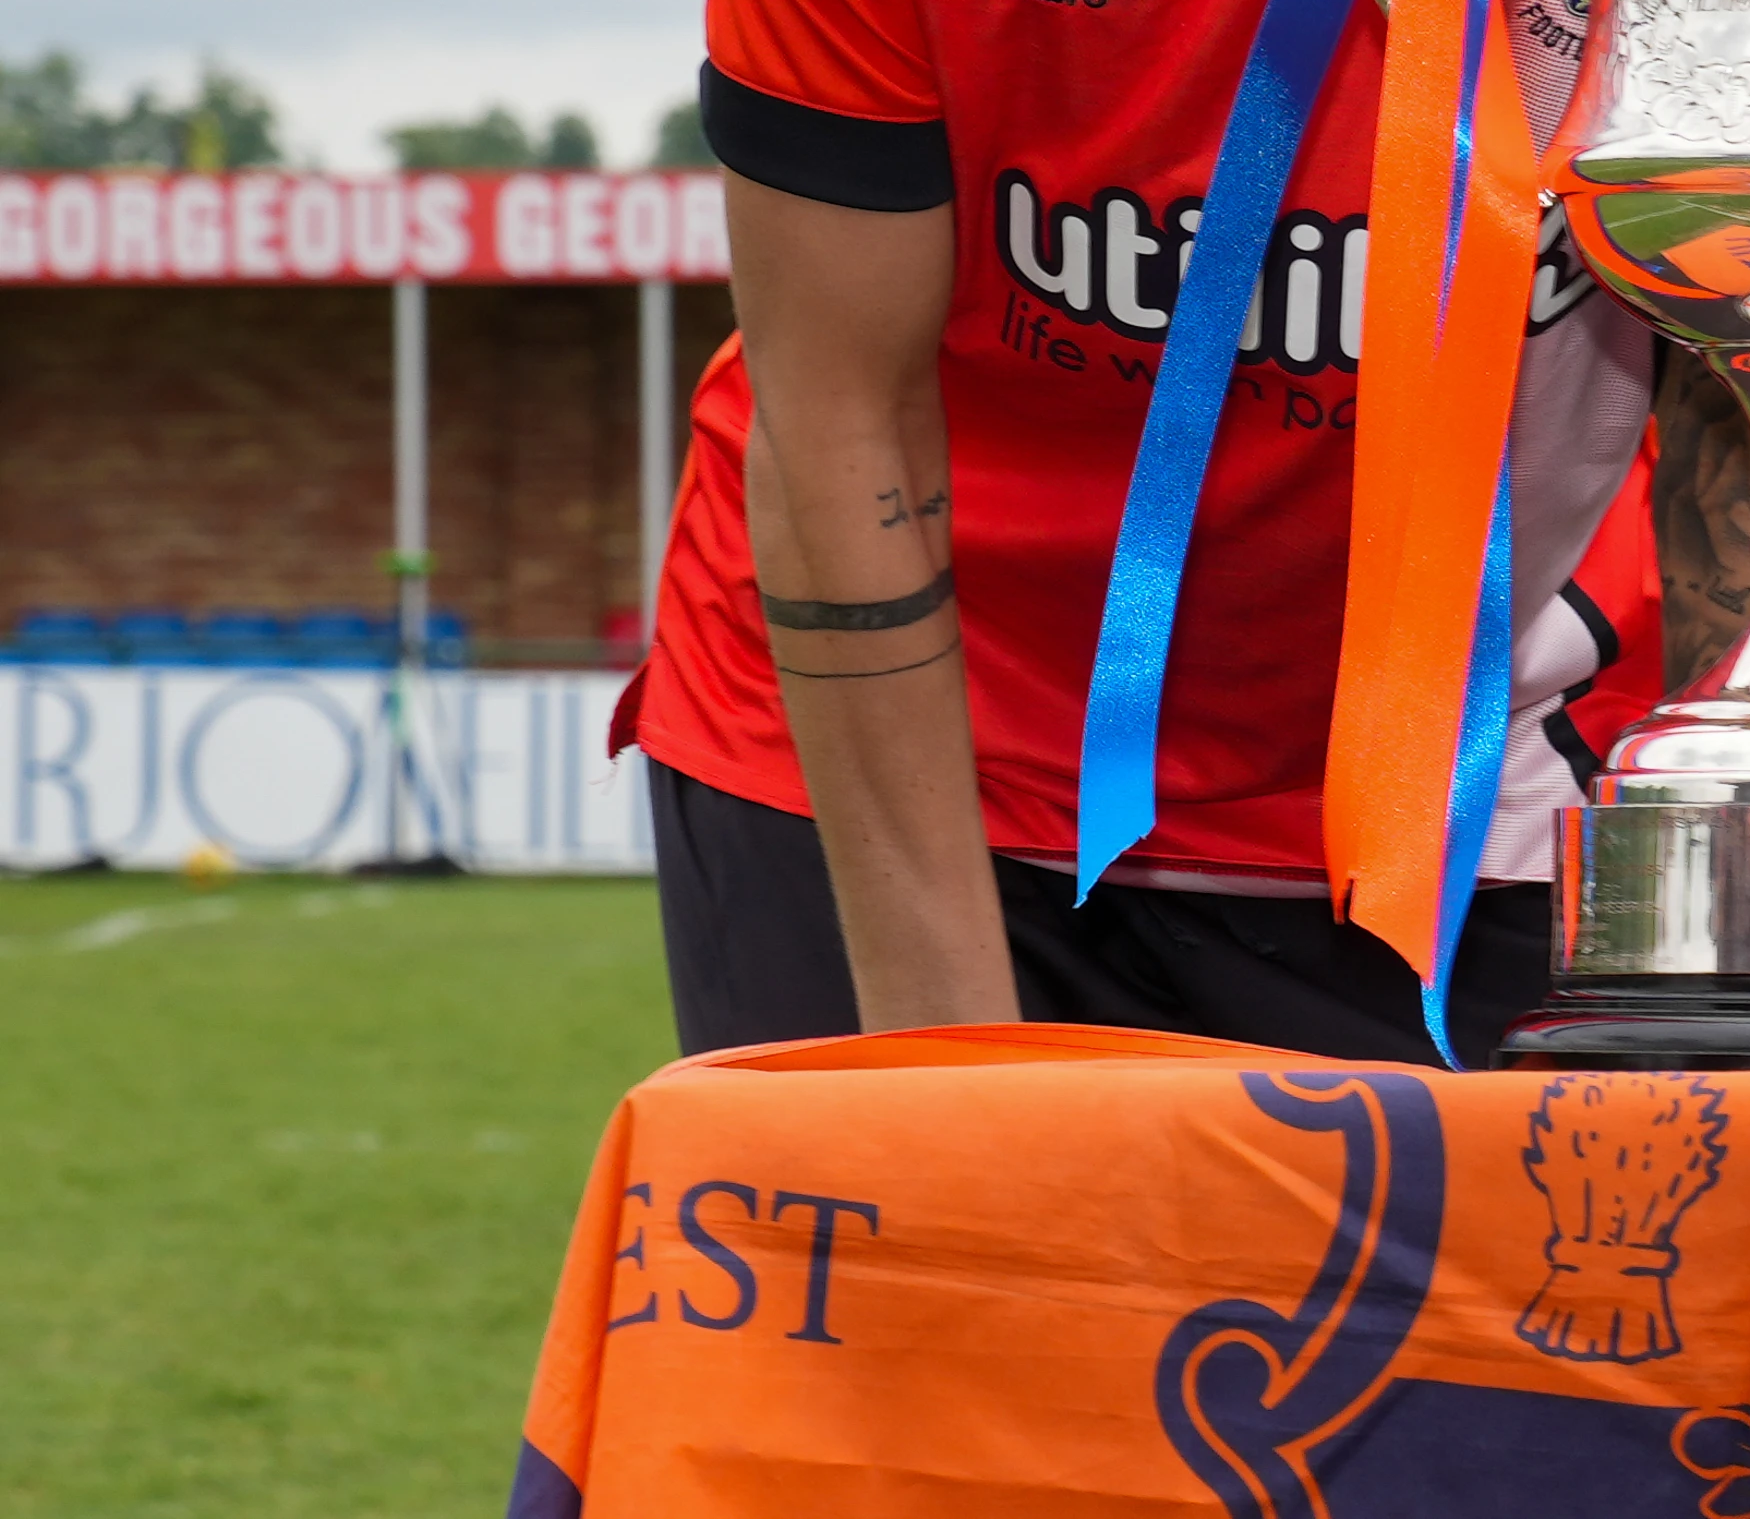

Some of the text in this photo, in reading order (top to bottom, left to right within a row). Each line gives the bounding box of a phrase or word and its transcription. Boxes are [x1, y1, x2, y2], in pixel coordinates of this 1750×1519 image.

[0, 172, 731, 279] GORGEOUS GEOR
[1001, 290, 1088, 372] life
